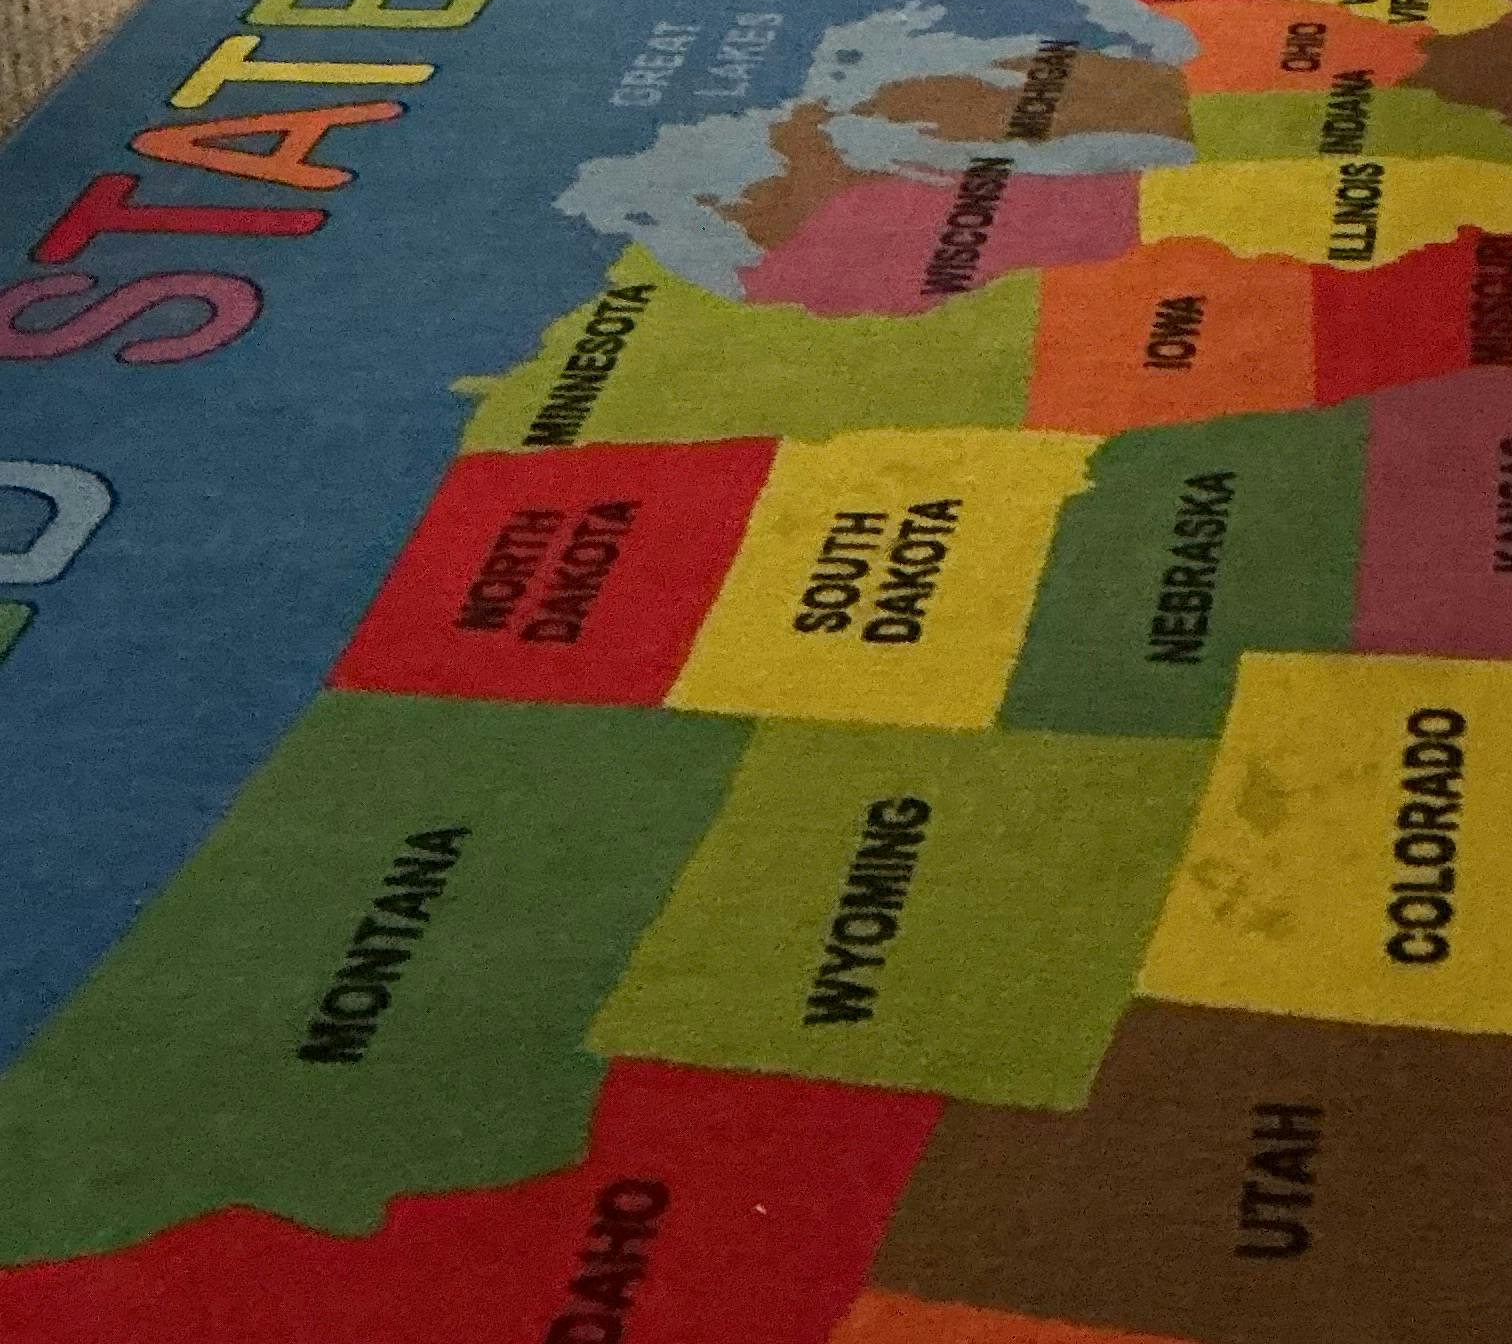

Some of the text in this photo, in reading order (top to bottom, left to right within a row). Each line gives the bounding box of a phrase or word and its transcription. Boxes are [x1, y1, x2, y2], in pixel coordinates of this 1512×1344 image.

[610, 21, 699, 108] GREAT
[693, 12, 784, 98] LAKES
[1006, 39, 1081, 141] MICHIGAN
[1280, 22, 1327, 73] OHIO
[1319, 67, 1375, 156] INDIANA
[919, 156, 1016, 296] WISCONSIN
[1328, 161, 1386, 262] ILLINOIS
[523, 281, 658, 447] MINNESOTA
[1143, 294, 1207, 372] IOWA
[456, 505, 564, 633] NORTH
[518, 497, 645, 646] DAKOTA
[792, 511, 889, 635] SOUTH
[860, 497, 965, 645] DAKOTA
[1145, 470, 1238, 665] NEBRASKA
[1383, 706, 1467, 965] COLORADO
[295, 824, 474, 1065] MONTANA
[803, 794, 932, 1028] WYOMING
[1233, 1102, 1324, 1260] UTAH
[542, 1176, 671, 1344] DAHO
